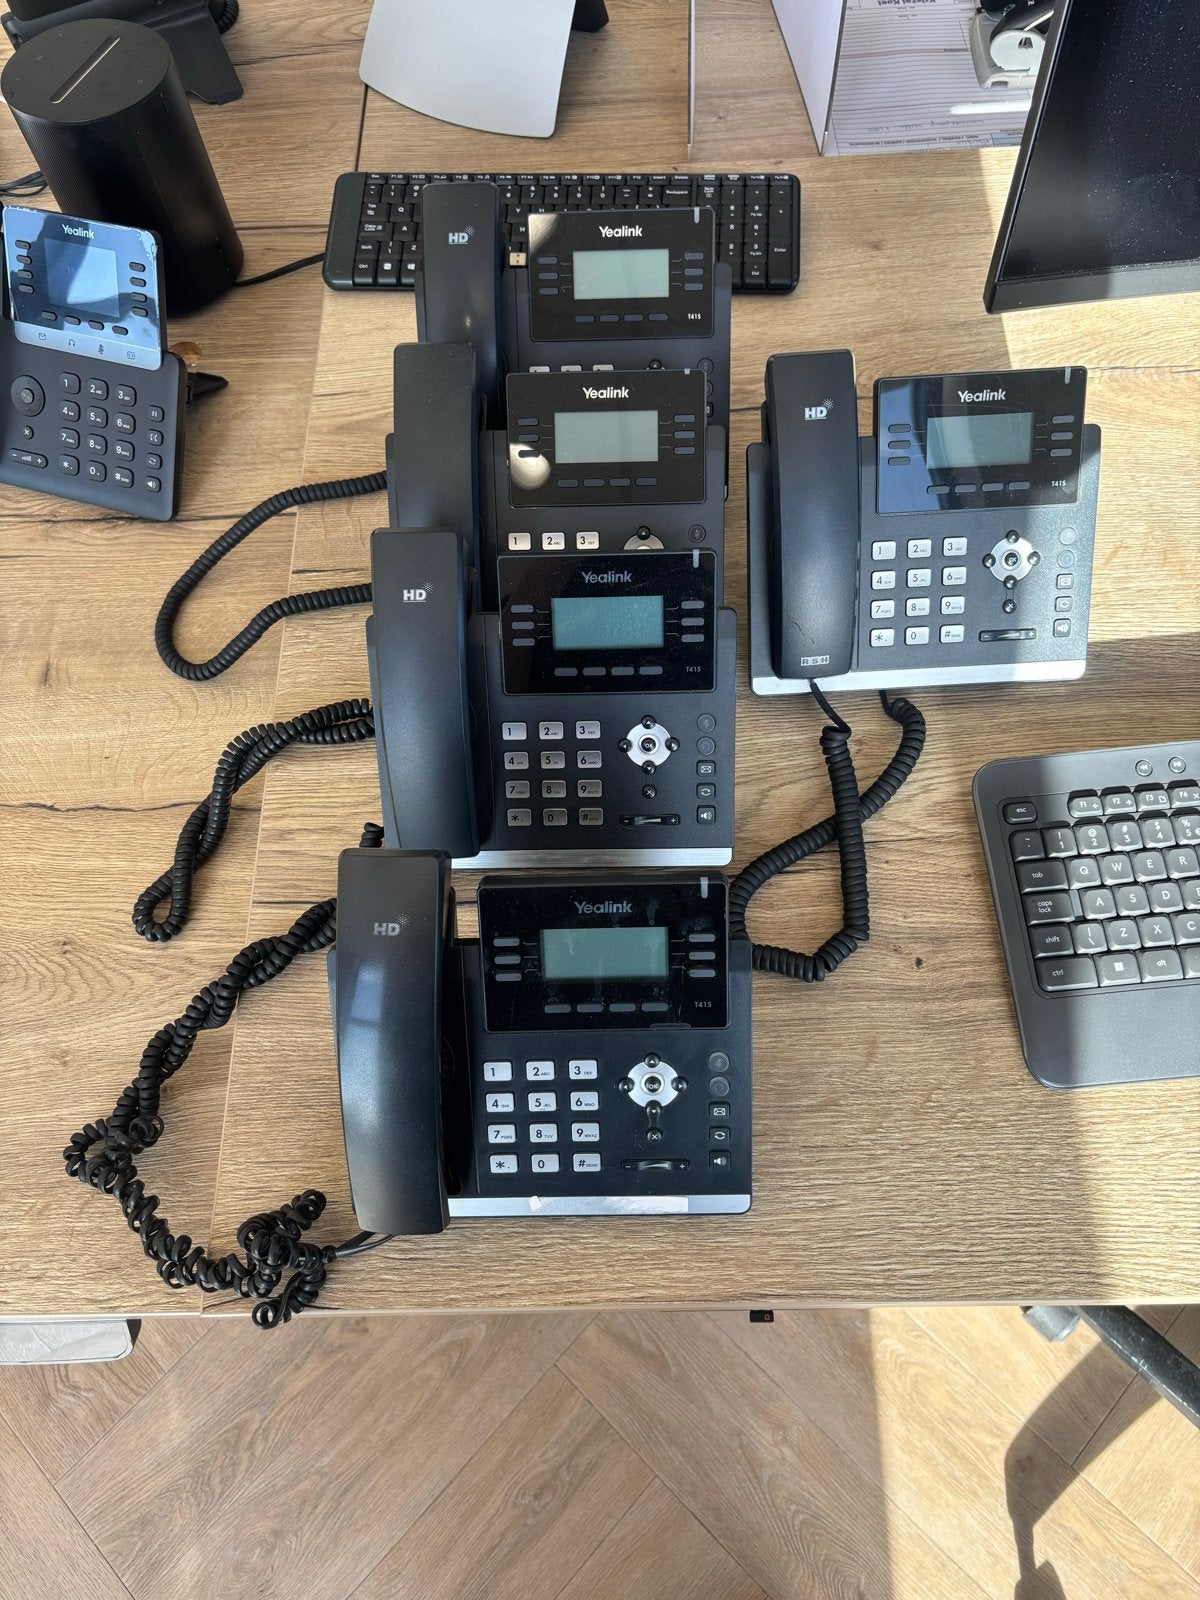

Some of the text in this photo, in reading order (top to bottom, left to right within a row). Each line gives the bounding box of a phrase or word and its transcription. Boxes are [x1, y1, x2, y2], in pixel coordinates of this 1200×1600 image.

[61, 224, 96, 240] Yealink
[598, 225, 643, 238] Yealink
[448, 232, 469, 244] HD
[64, 379, 68, 387] 1
[90, 384, 96, 393] 2
[582, 386, 630, 400] Yealink
[118, 390, 124, 399] 3
[958, 388, 1006, 403] Yealink
[62, 406, 68, 415] 4
[804, 406, 828, 419] HD
[89, 412, 95, 421] 5
[117, 418, 123, 427] 6
[61, 433, 67, 441] 7
[89, 439, 95, 448] 8
[115, 445, 122, 454] 9
[89, 466, 96, 475] 0
[115, 472, 121, 480] #
[513, 536, 517, 546] 1
[546, 536, 553, 546] 2
[580, 535, 586, 545] 3
[878, 546, 882, 555] 1
[912, 544, 919, 553] 2
[947, 542, 953, 551] 3
[581, 570, 633, 584] Yealink
[876, 576, 883, 585] 4
[912, 573, 919, 582] 5
[946, 572, 953, 581] 6
[403, 589, 427, 601] HD
[875, 605, 881, 614] 7
[910, 603, 917, 612] 8
[944, 601, 951, 610] 9
[910, 631, 917, 640] 0
[944, 630, 951, 638] #
[507, 727, 511, 736] 1
[543, 726, 550, 736] 2
[579, 725, 586, 735] 3
[508, 756, 515, 765] 4
[545, 755, 551, 765] 5
[580, 755, 587, 765] 6
[509, 785, 516, 795] 7
[546, 785, 552, 794] 8
[580, 785, 587, 794] 9
[1112, 797, 1121, 805] F2
[547, 813, 554, 822] 0
[582, 813, 589, 821] #
[1154, 821, 1161, 830] $
[1181, 819, 1191, 827] %
[1156, 831, 1163, 839] 4
[1185, 828, 1192, 837] 5
[1091, 838, 1098, 846] 2
[1123, 834, 1131, 842] 3
[1060, 841, 1064, 849] 1
[1146, 859, 1154, 869] E
[1179, 856, 1188, 865] R
[1079, 866, 1090, 875] Q
[1111, 862, 1122, 872] W
[1031, 871, 1044, 879] tab
[1129, 893, 1137, 903] S
[1161, 890, 1171, 900] D
[1037, 900, 1053, 908] caps
[1096, 897, 1105, 907] A
[574, 900, 633, 914] Yealink
[373, 922, 400, 935] HD
[1153, 924, 1162, 934] X
[1187, 921, 1197, 931] C
[1119, 927, 1128, 937] Z
[1045, 935, 1060, 944] shift
[1051, 968, 1064, 977] ctrl
[490, 1067, 496, 1077] 1
[532, 1066, 540, 1077] 2
[574, 1065, 581, 1075] 3
[491, 1099, 499, 1108] 4
[534, 1098, 542, 1108] 5
[575, 1097, 583, 1107] 6
[493, 1130, 501, 1139] 7
[535, 1129, 543, 1139] 8
[576, 1128, 584, 1138] 9
[537, 1159, 545, 1169] 0
[578, 1159, 586, 1168] #
